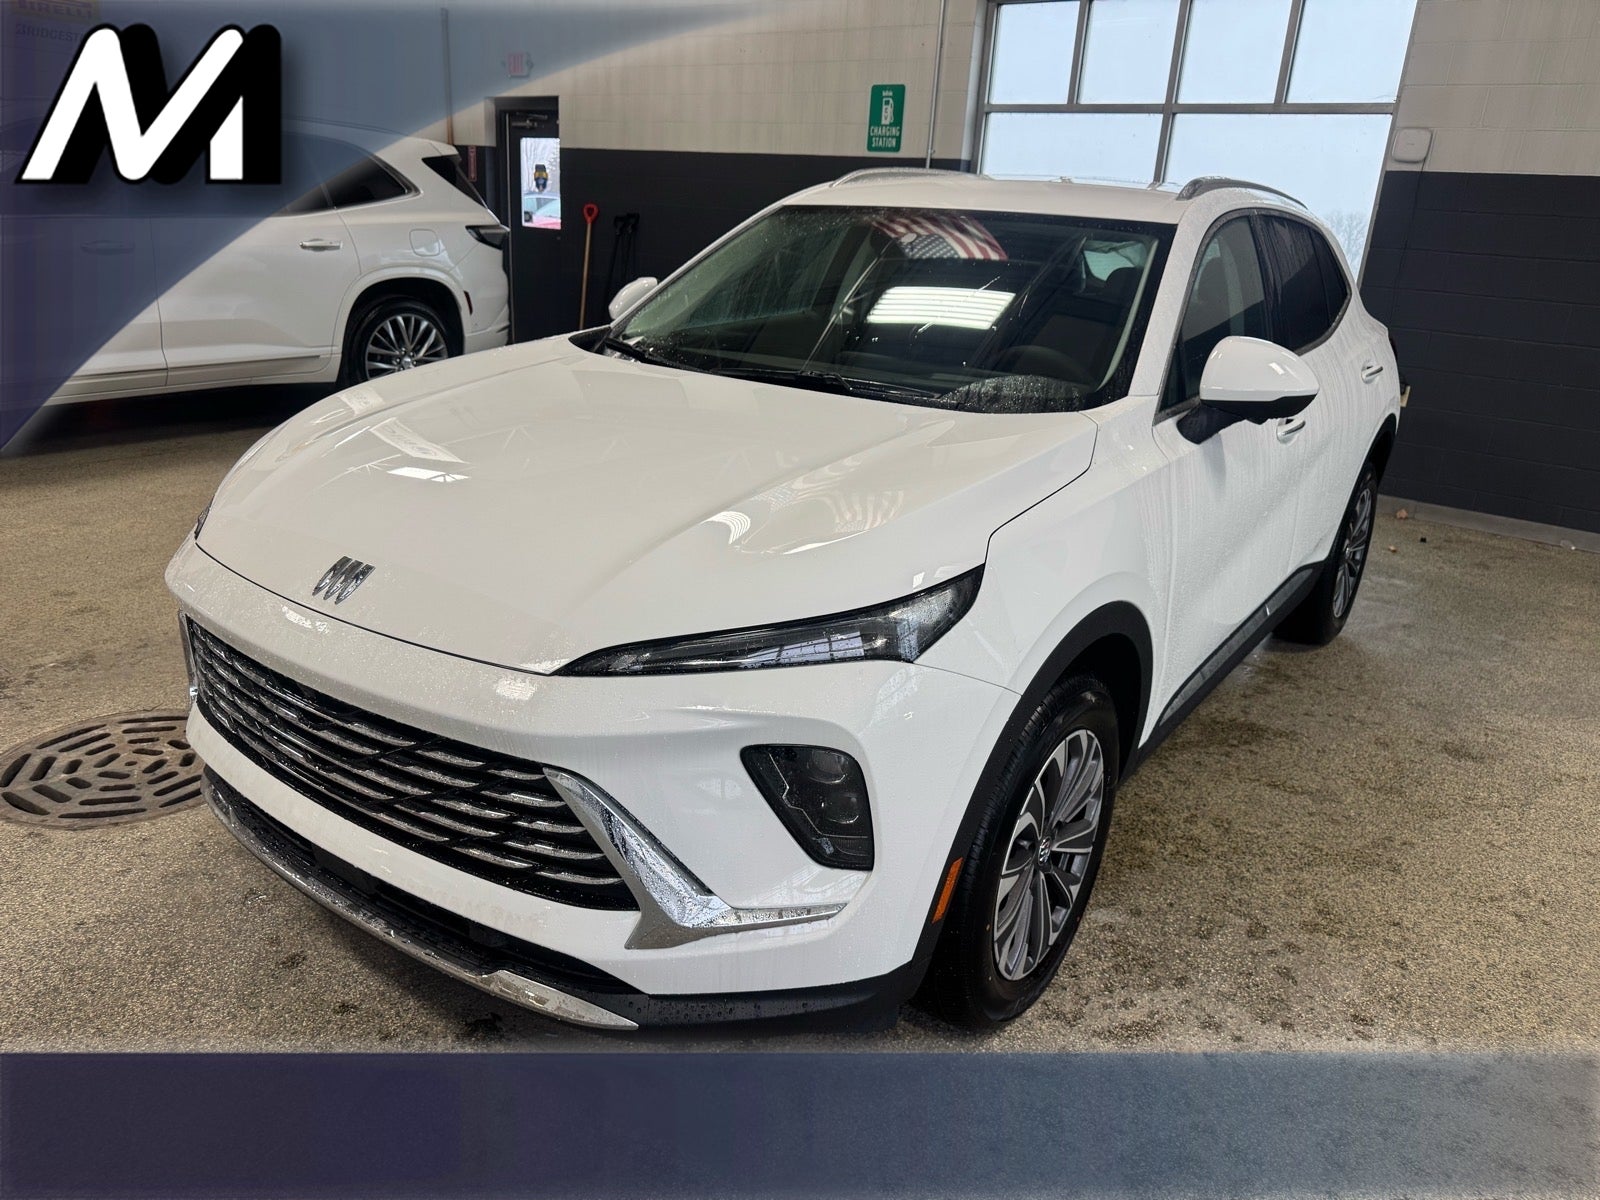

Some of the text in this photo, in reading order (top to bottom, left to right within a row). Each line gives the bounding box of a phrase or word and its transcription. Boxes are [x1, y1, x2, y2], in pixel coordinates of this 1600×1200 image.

[16, 23, 83, 42] BRIDGEST
[870, 126, 900, 136] CHARGING
[872, 137, 896, 147] STATION
